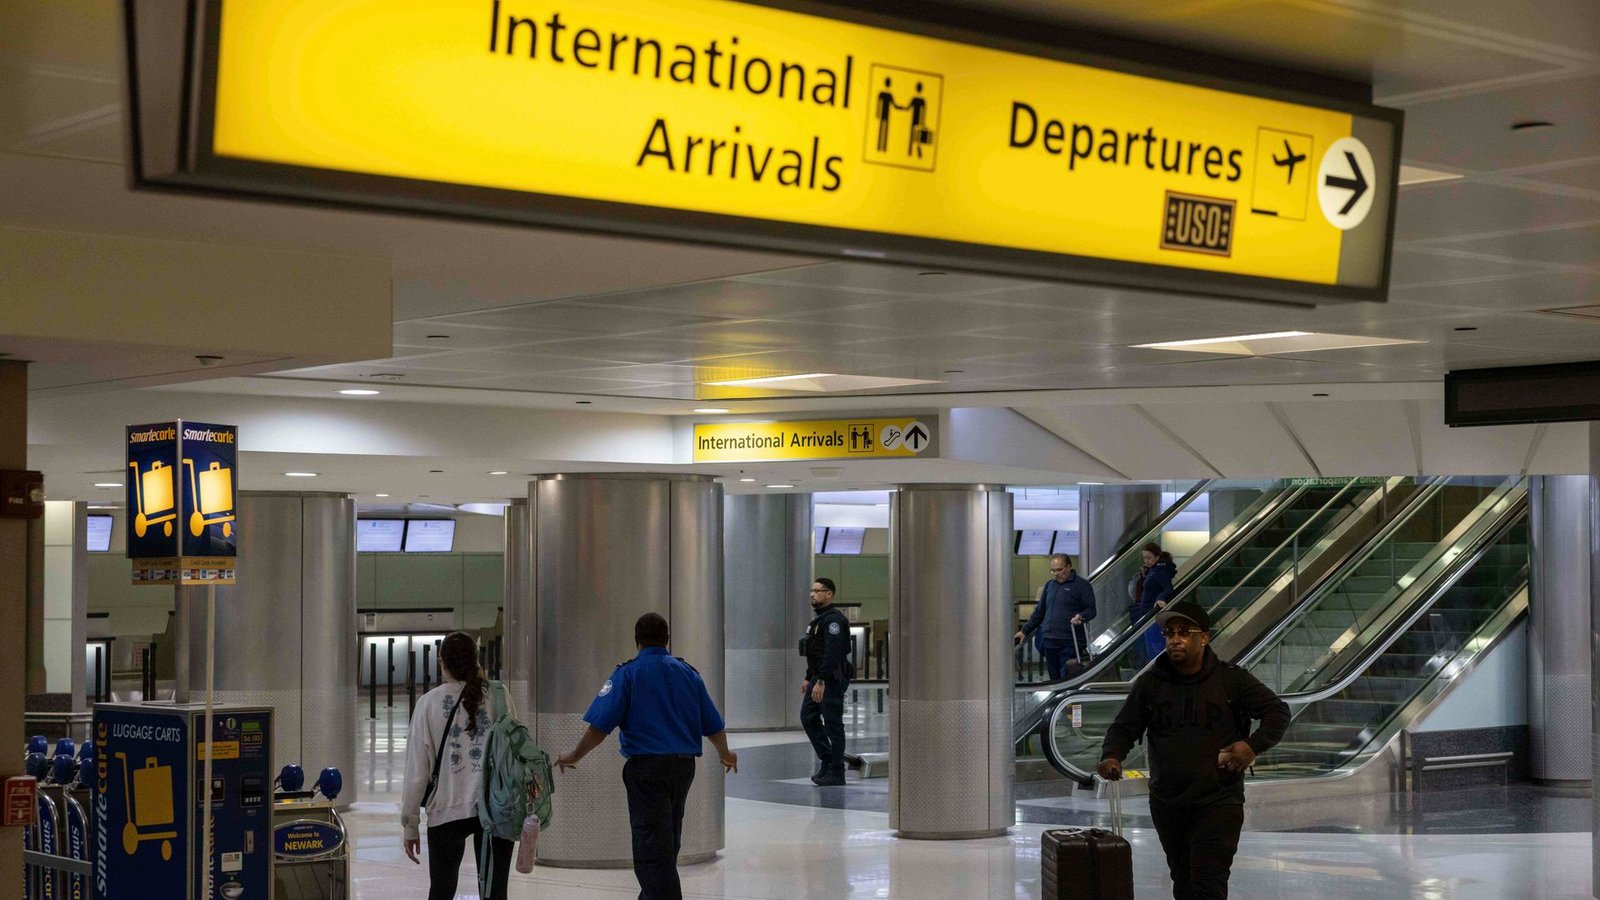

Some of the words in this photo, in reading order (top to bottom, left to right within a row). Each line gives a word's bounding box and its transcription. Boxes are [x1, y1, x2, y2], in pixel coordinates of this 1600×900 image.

[490, 0, 854, 109] International
[1009, 101, 1244, 182] Departures
[636, 118, 844, 192] Arrivals
[1175, 201, 1222, 247] USO
[129, 427, 176, 443] smartecarte
[183, 428, 234, 443] smartecarte
[698, 432, 785, 450] International
[790, 430, 844, 448] Arrivals
[113, 724, 153, 740] LUGGAGE
[155, 727, 181, 742] CARTS
[285, 840, 323, 851] NEWARK
